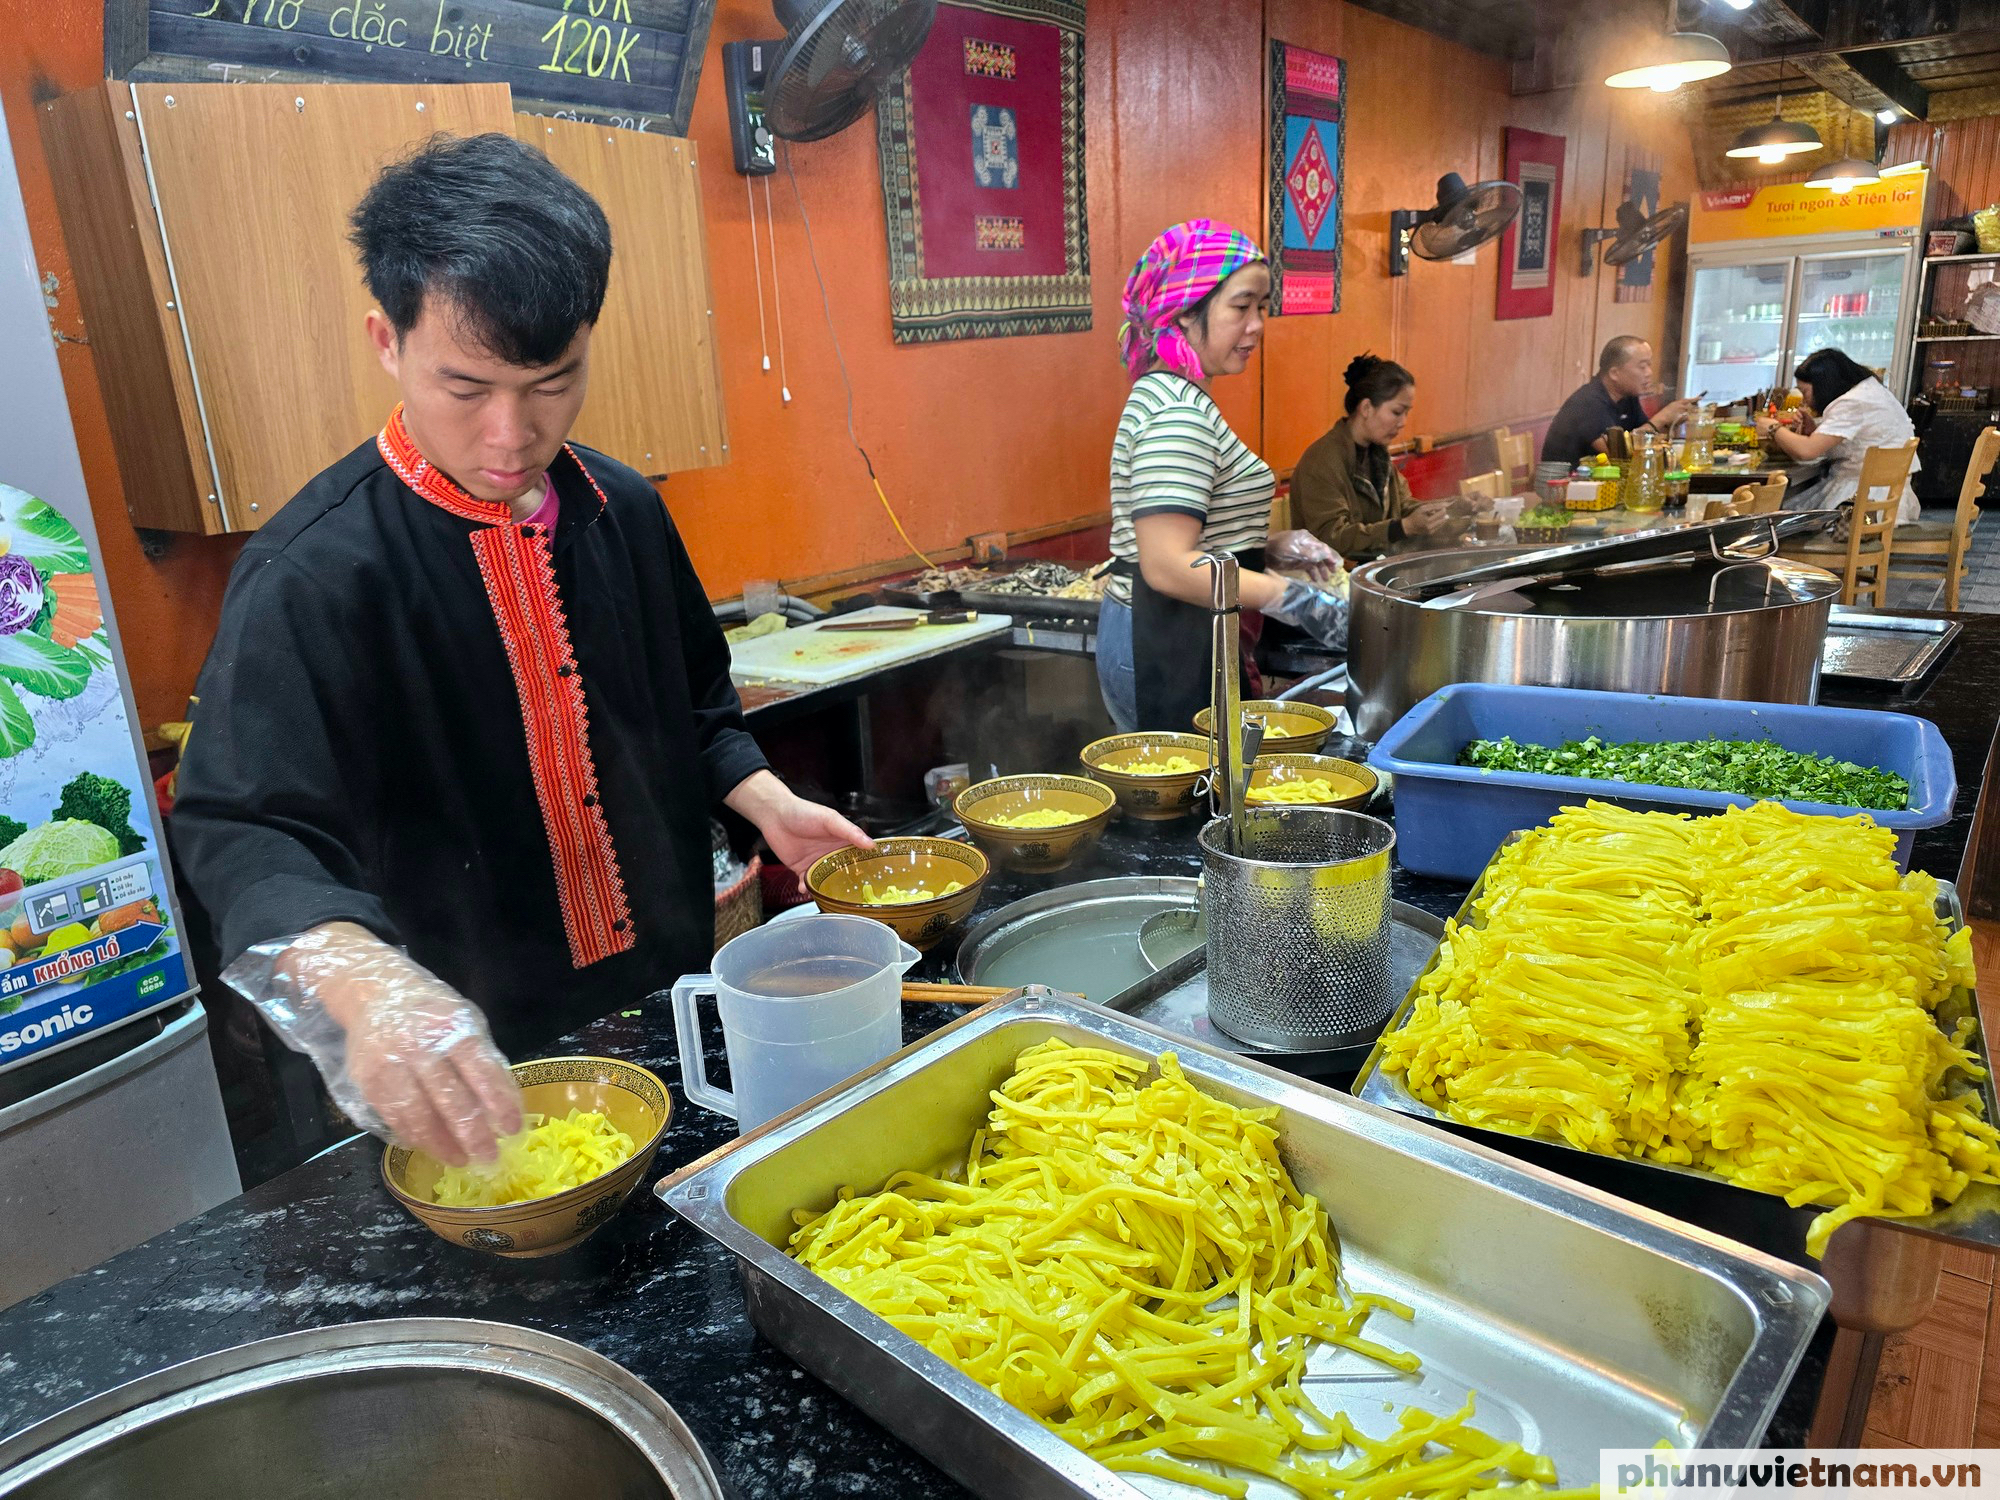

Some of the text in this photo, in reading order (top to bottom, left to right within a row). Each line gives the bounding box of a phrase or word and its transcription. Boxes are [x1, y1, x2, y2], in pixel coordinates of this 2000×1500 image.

[430, 0, 494, 68] biệt
[538, 15, 641, 83] 120K
[1800, 198, 1835, 213] ngon
[1840, 195, 1851, 207] &
[1856, 192, 1887, 207] Tiện
[1, 974, 28, 993] ẩm
[140, 975, 165, 994] eco ideas
[0, 1004, 94, 1054] sonic
